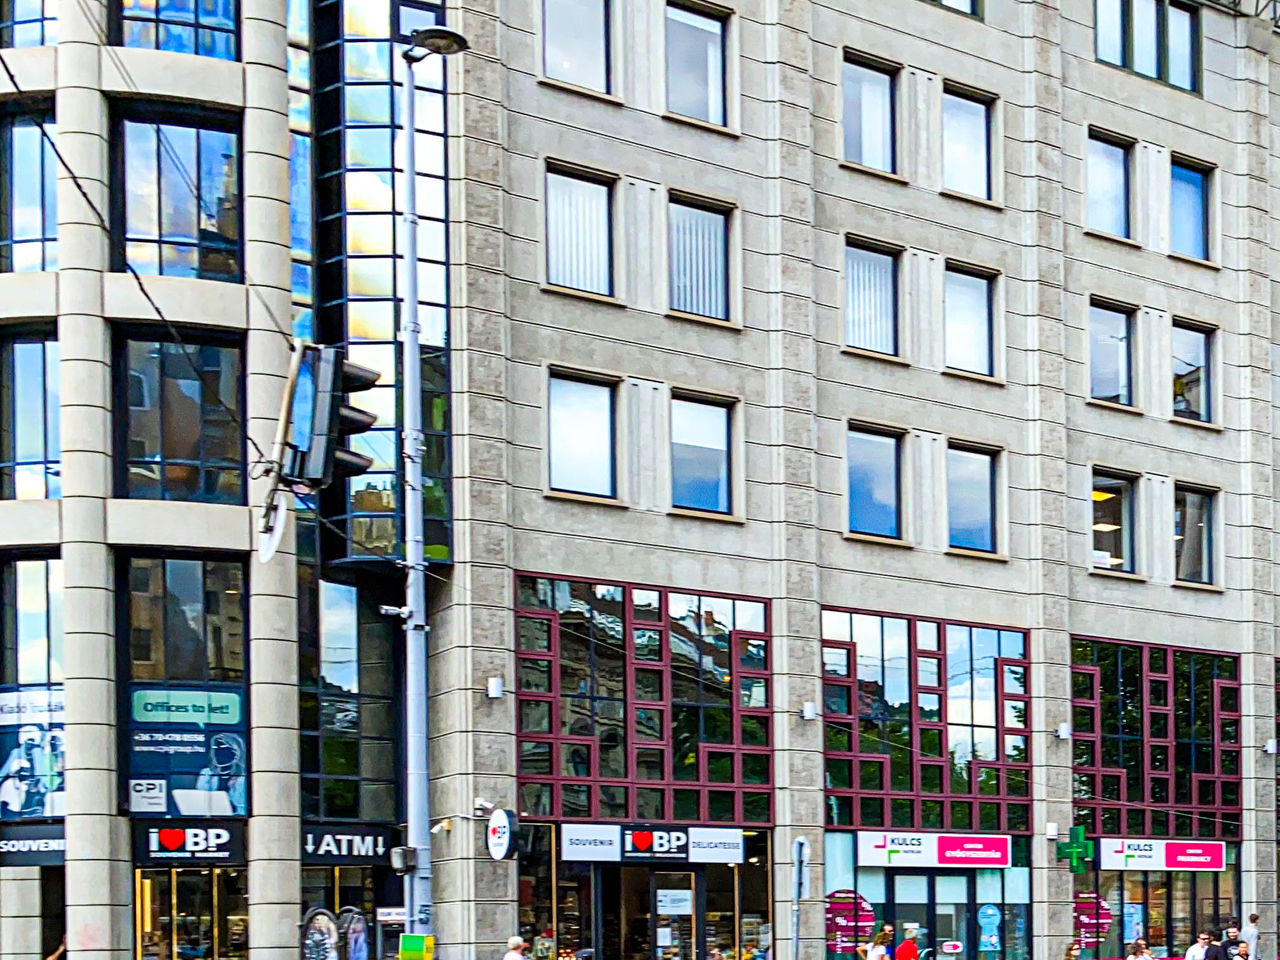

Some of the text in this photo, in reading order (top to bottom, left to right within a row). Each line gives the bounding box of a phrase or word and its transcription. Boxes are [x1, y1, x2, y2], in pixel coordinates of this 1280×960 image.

[143, 702, 230, 714] Offices to let!
[132, 783, 163, 793] CPI
[317, 834, 374, 856] ATM
[568, 837, 614, 847] SOUVENIR
[691, 841, 741, 850] DELICATESSE
[890, 837, 922, 846] KULCS
[1127, 844, 1153, 852] KULCS
